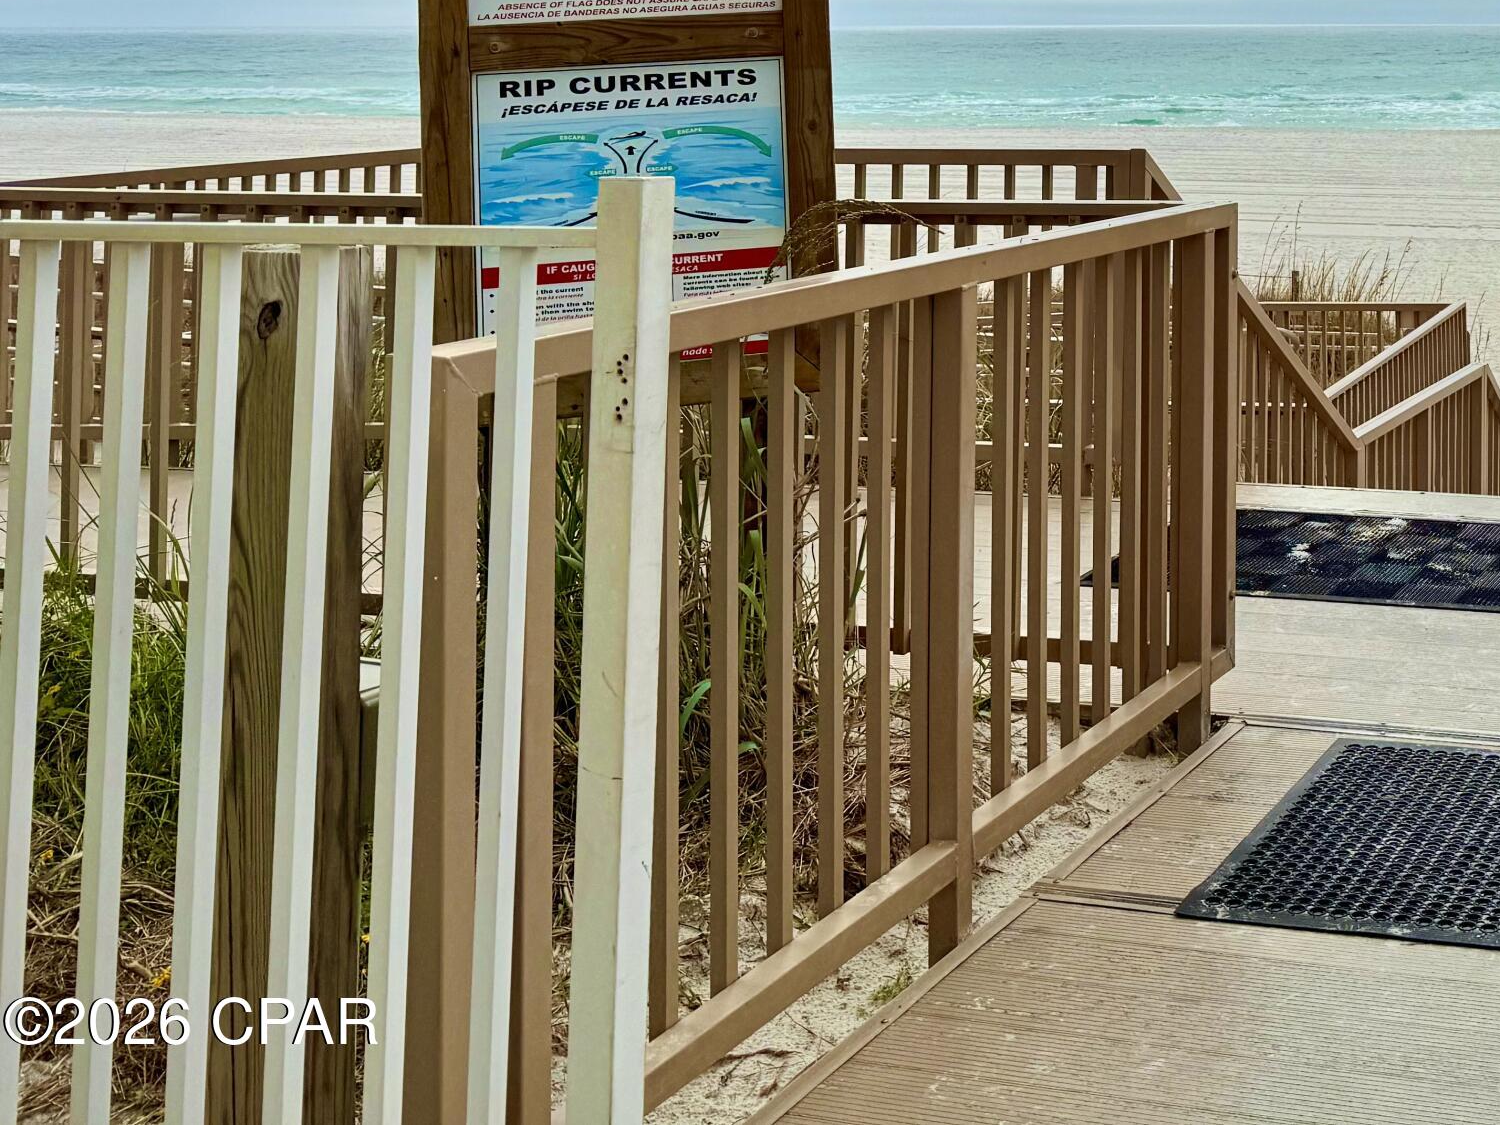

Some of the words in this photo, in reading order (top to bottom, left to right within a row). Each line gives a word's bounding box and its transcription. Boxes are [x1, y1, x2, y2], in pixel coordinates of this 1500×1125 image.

[492, 11, 546, 20] AUSENCIA
[547, 10, 561, 18] DE
[563, 8, 620, 17] BANDERAS
[622, 7, 638, 15] NO
[640, 5, 688, 13] ASEGURA
[690, 3, 725, 11] AGUAS
[728, 0, 776, 9] SEGURAS
[497, 2, 547, 11] ABSENCE
[549, 1, 564, 9] OF
[566, 0, 593, 8] FLAG
[499, 79, 556, 99] RIP
[568, 68, 758, 95] CURRENTS
[501, 98, 610, 119] ¡ESCÁPESE
[614, 98, 641, 111] DE
[645, 96, 670, 108] LA
[675, 92, 758, 107] RESACA!
[677, 127, 703, 135] ESCAPE
[589, 168, 616, 177] ESCAPE
[647, 165, 673, 173] ESCAPE
[672, 253, 723, 265] URRENT
[546, 266, 559, 275] IF
[561, 263, 596, 274] CAUG
